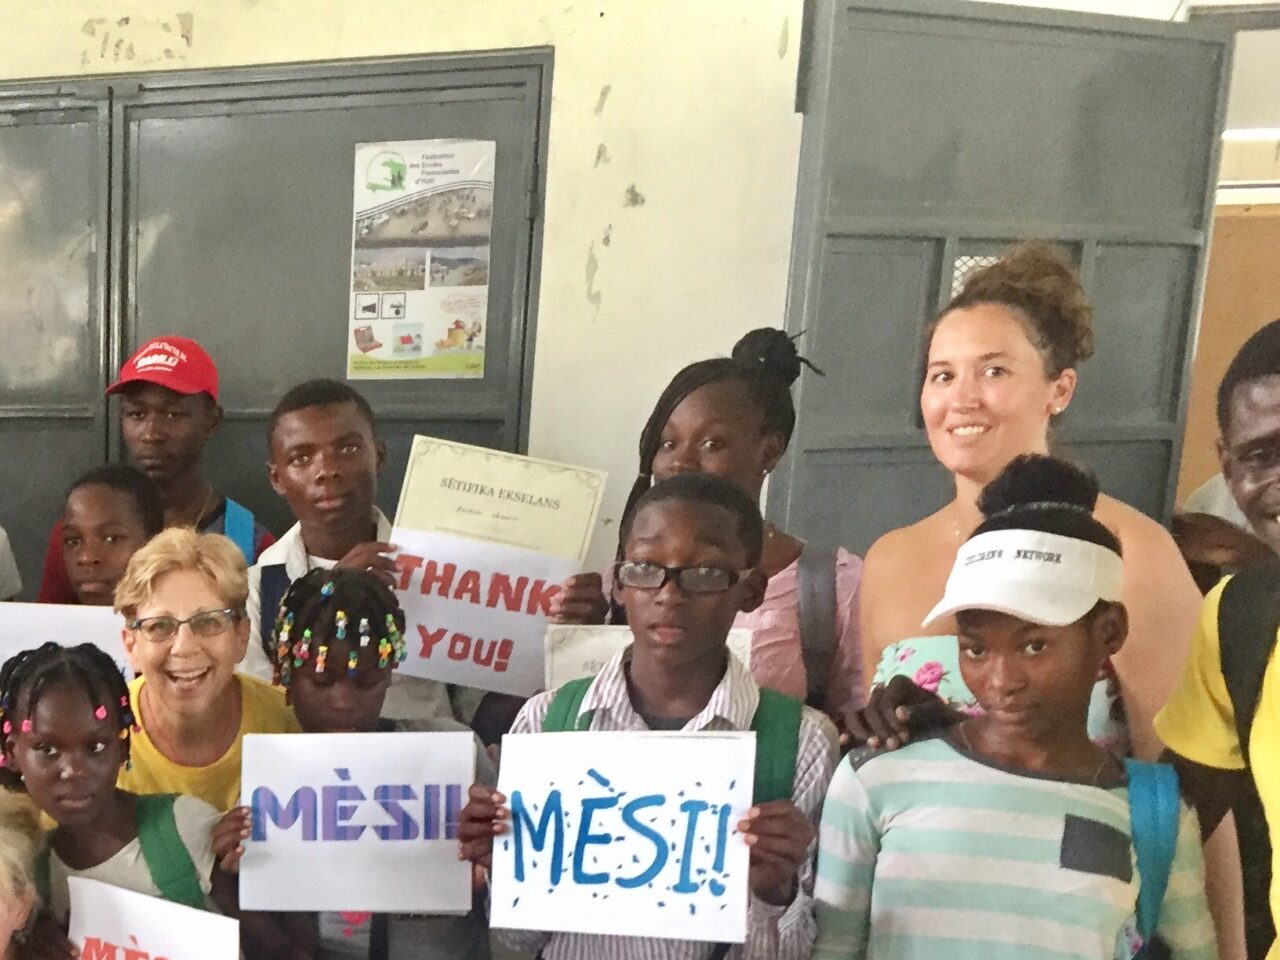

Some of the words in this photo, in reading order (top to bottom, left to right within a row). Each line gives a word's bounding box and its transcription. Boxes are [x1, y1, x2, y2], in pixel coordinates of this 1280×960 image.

[498, 488, 561, 510] EKSELANS
[394, 554, 563, 617] THANK
[417, 623, 514, 672] YOU!
[511, 768, 732, 896] MÈSI!
